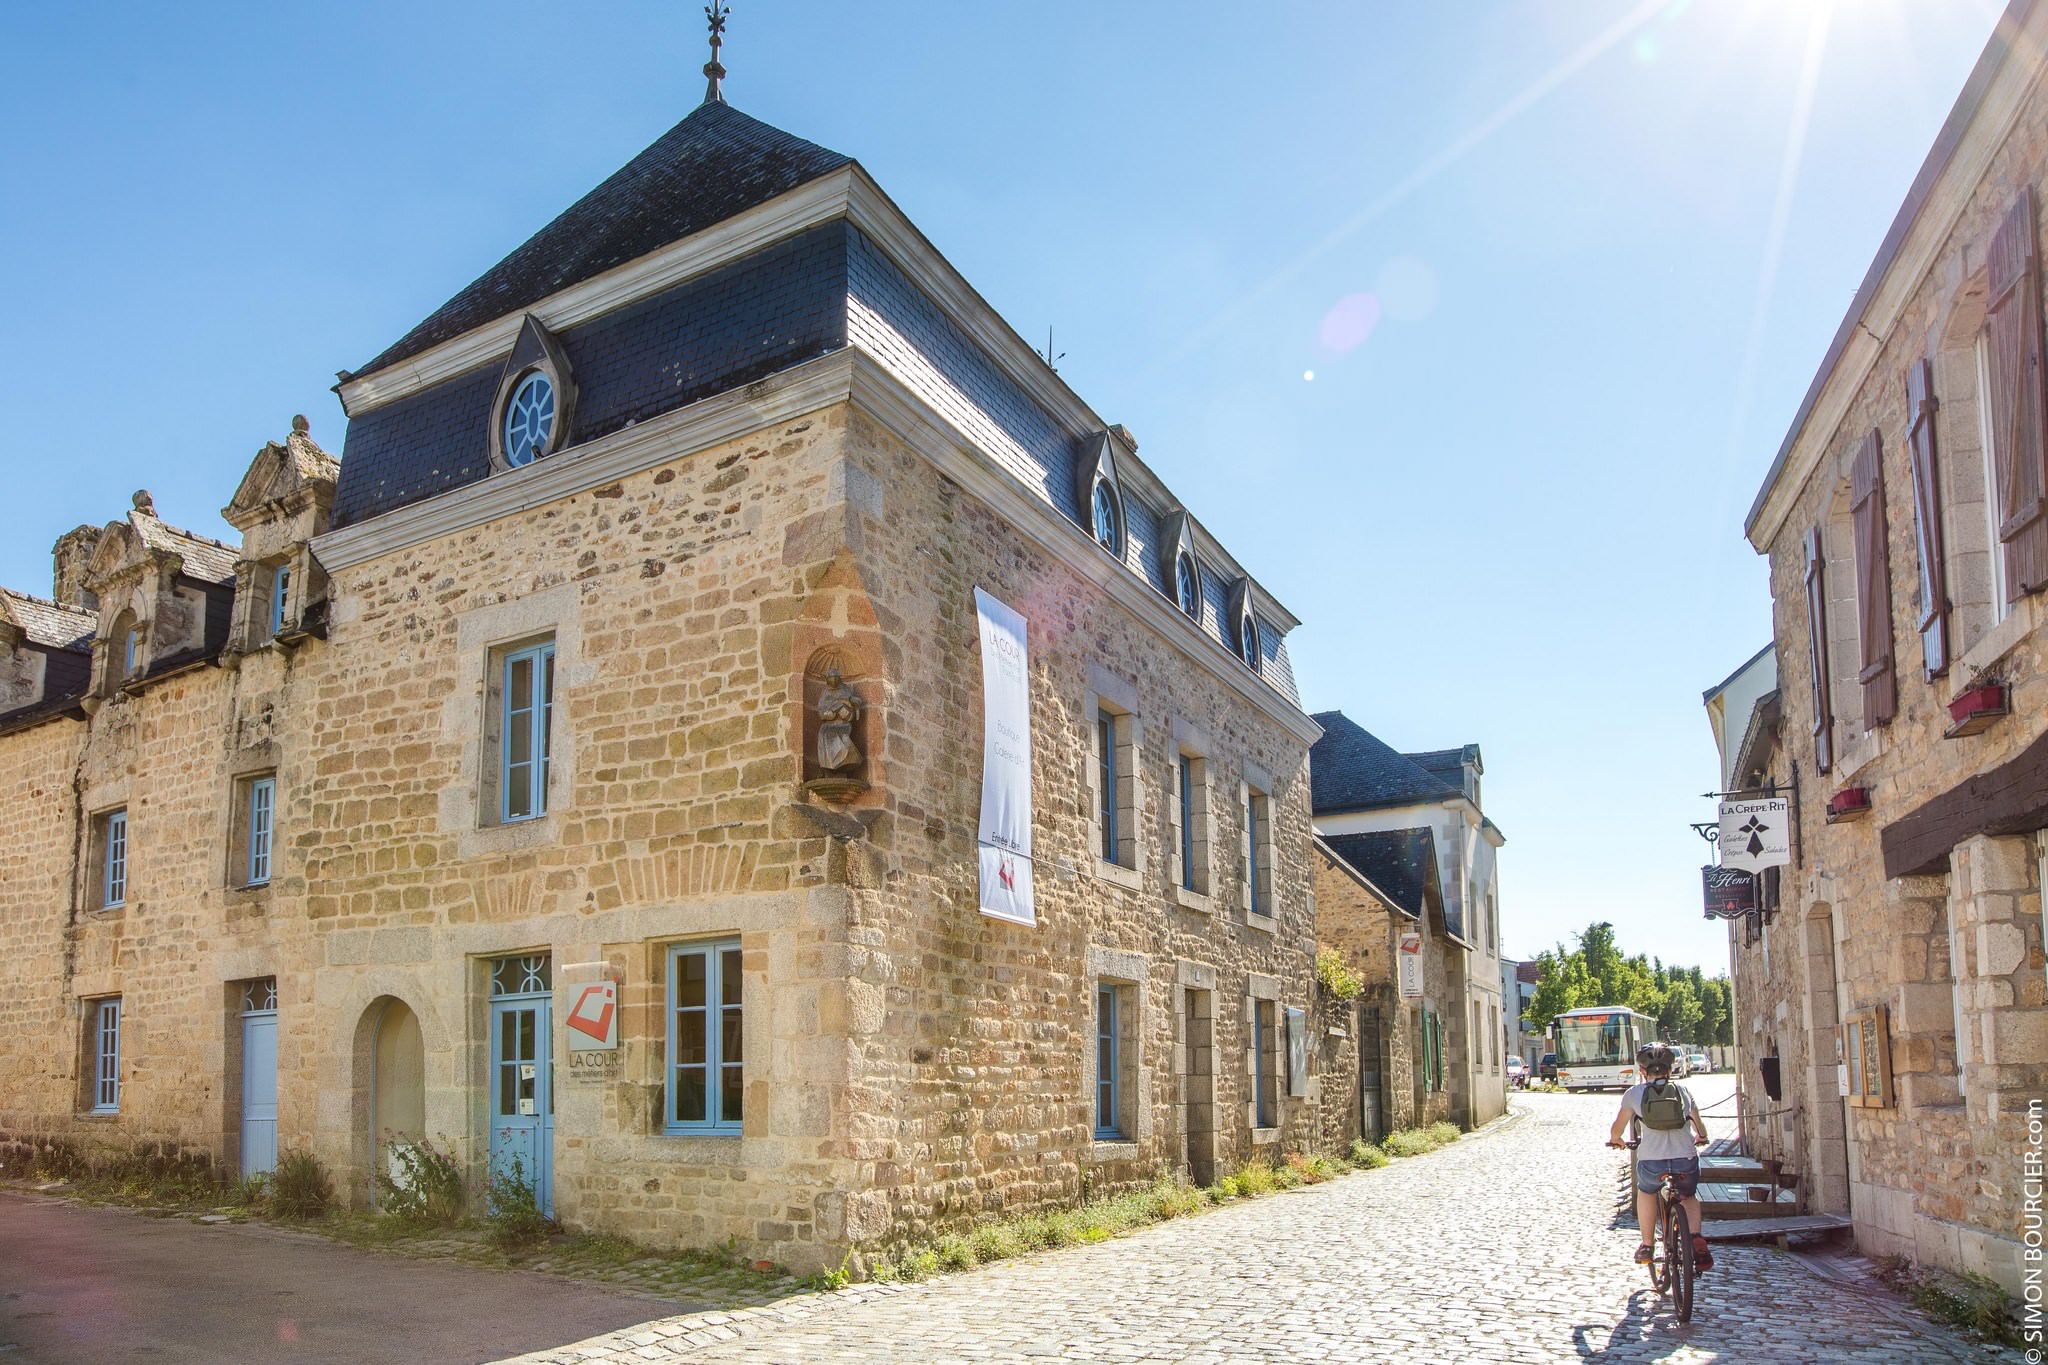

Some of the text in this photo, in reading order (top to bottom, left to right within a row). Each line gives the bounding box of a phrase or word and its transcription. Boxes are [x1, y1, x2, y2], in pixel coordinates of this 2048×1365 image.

[989, 630, 999, 649] LA
[999, 637, 1020, 665] COUR
[1710, 873, 1752, 887] Henri
[1408, 977, 1414, 987] LA
[569, 1052, 618, 1068] LA COUR
[570, 1070, 581, 1079] des
